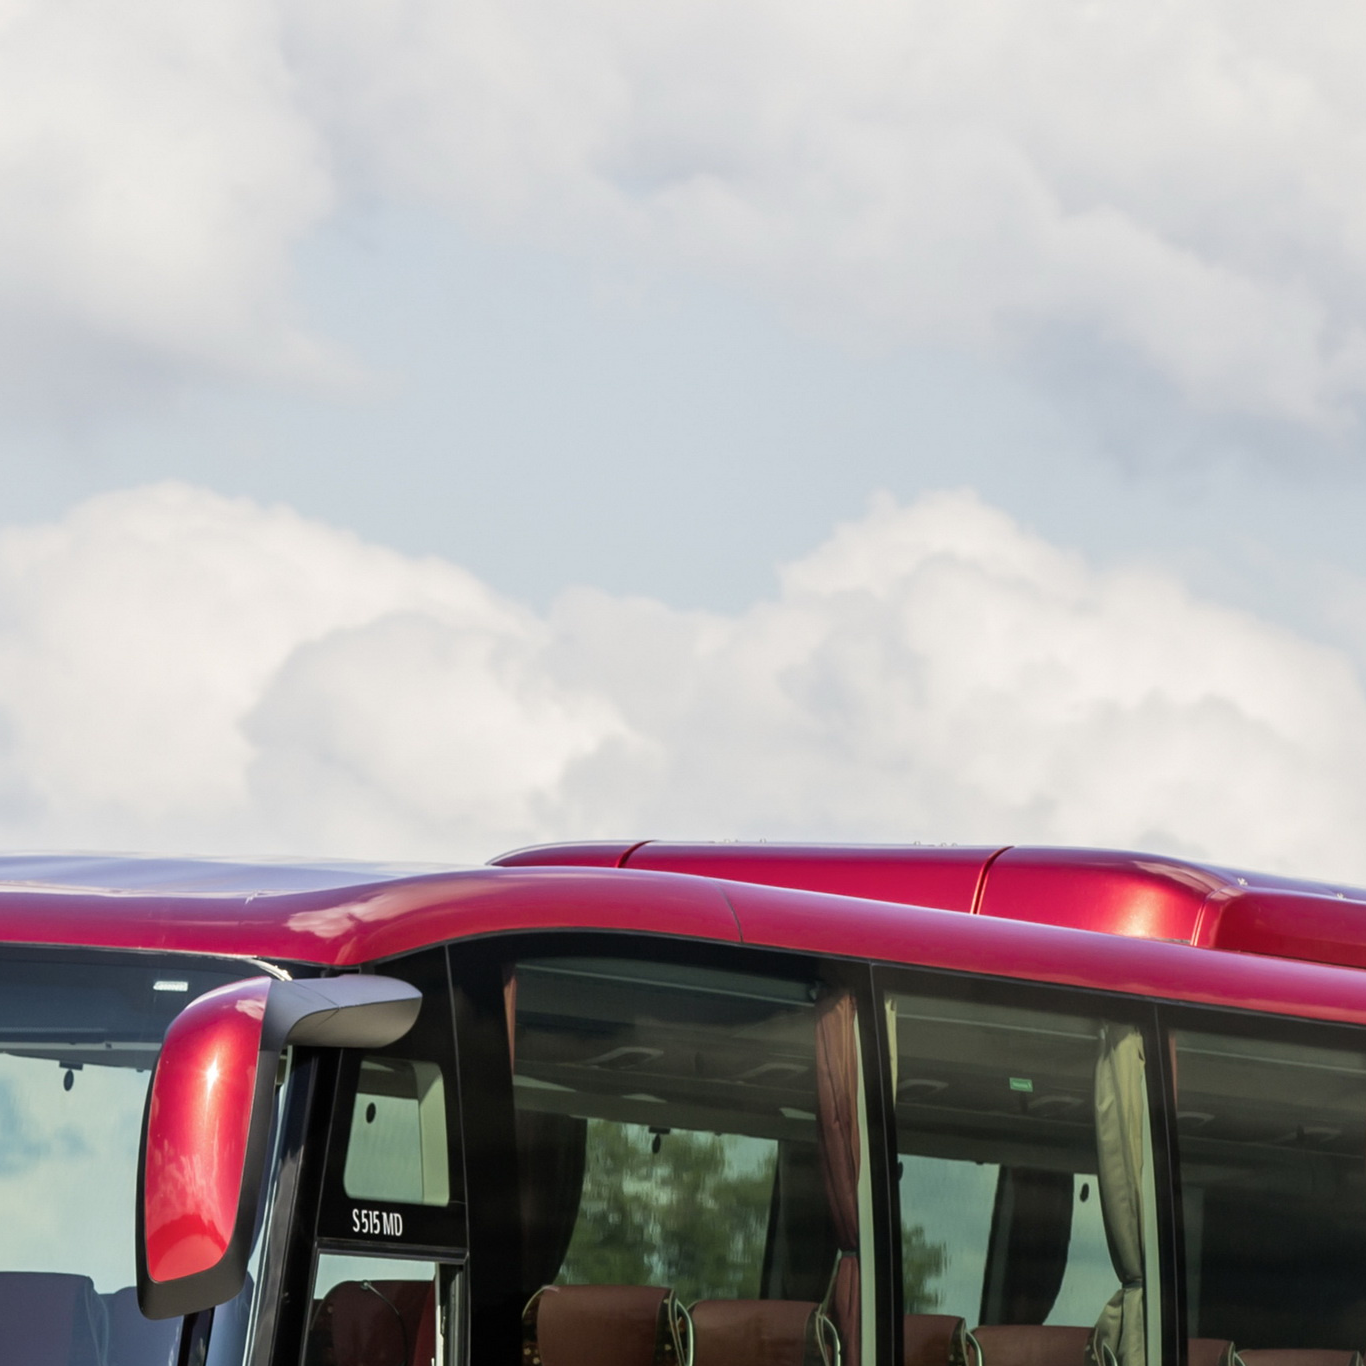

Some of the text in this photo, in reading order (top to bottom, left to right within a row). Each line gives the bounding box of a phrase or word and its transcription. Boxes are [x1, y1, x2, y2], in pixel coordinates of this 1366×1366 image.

[352, 1208, 403, 1236] S 515 MD
